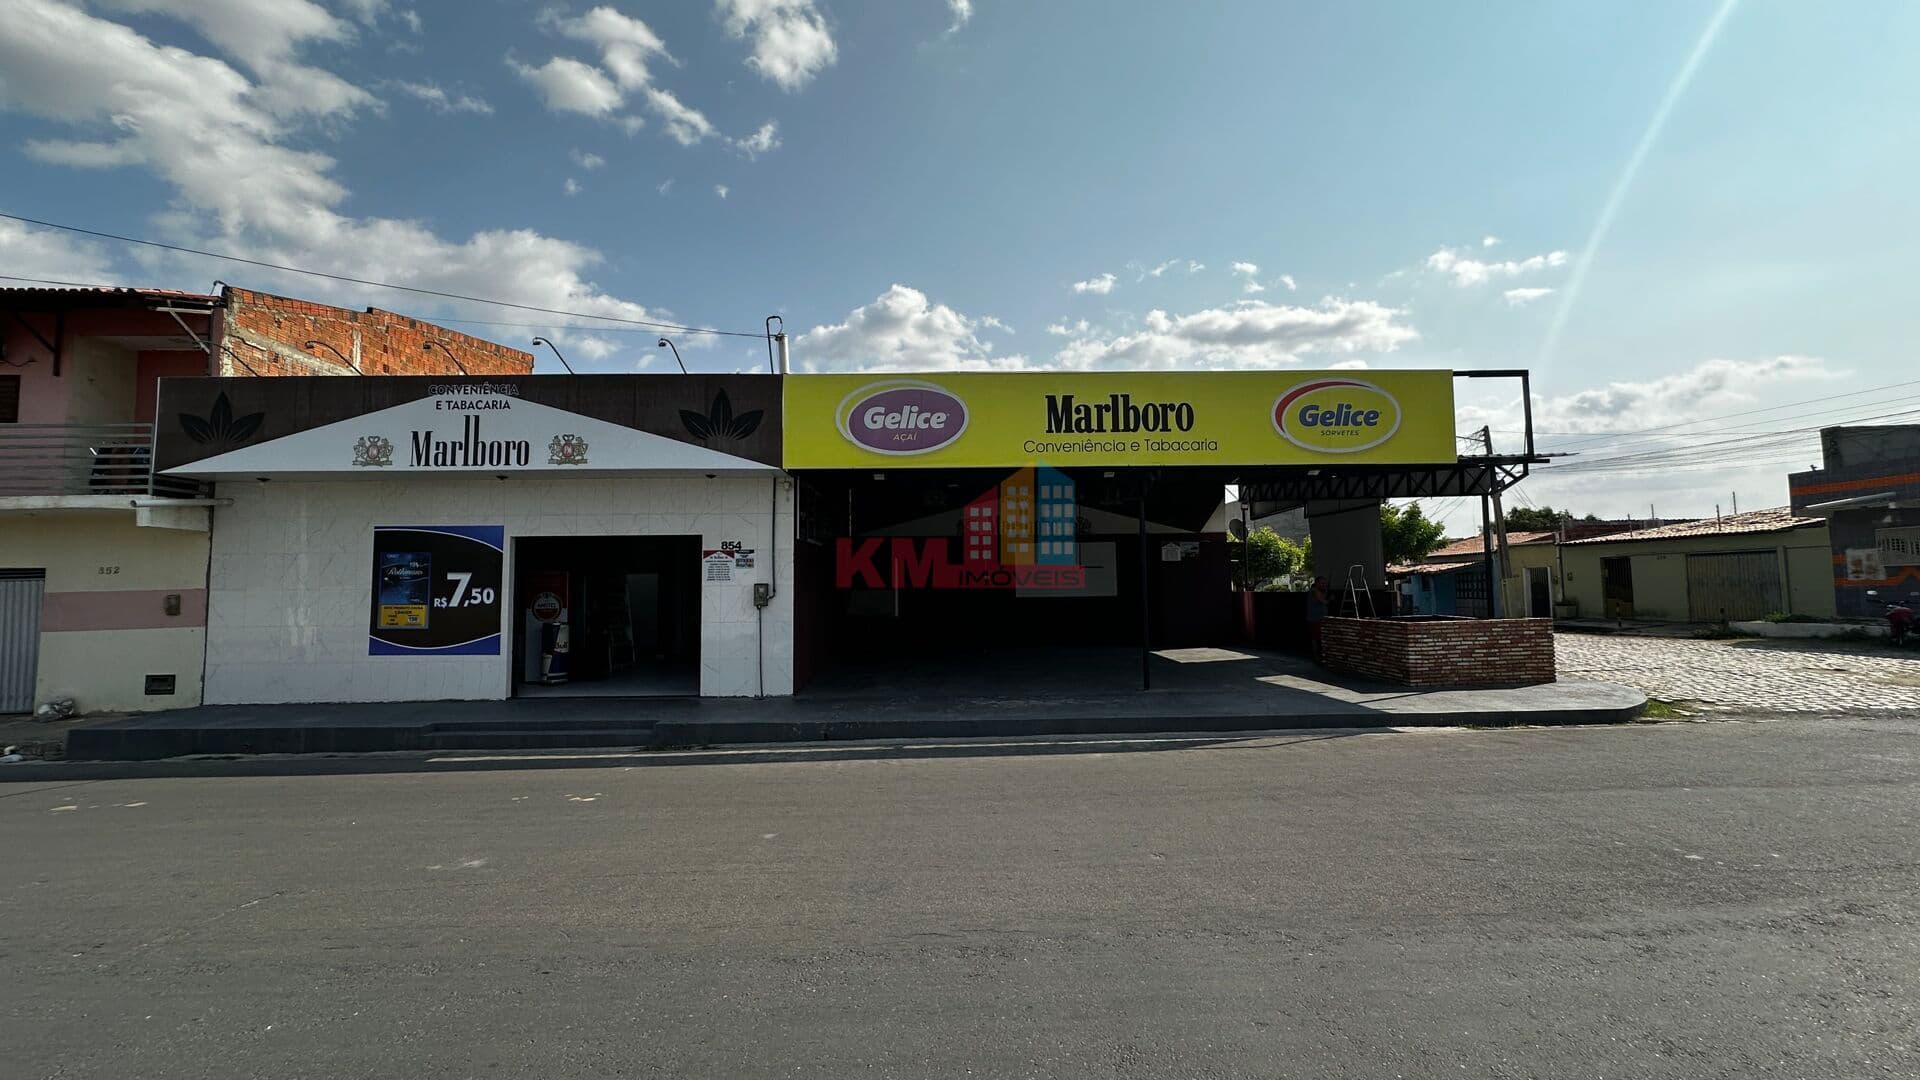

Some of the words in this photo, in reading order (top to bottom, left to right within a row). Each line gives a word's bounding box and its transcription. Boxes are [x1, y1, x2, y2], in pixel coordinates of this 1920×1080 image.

[428, 381, 520, 396] CONVENIÊNCIA
[435, 400, 442, 410] E
[447, 399, 511, 410] TABACARIA
[863, 405, 947, 430] Gelice
[1045, 394, 1195, 433] Marlboro
[1299, 403, 1380, 427] Gelice
[893, 433, 917, 443] AÇAÍ
[1320, 429, 1360, 437] SORVETES
[409, 415, 530, 467] Marlboro
[1023, 438, 1126, 454] Conveniência
[1130, 442, 1140, 451] e
[1144, 438, 1218, 451] Tabacaria
[721, 541, 742, 551] 854
